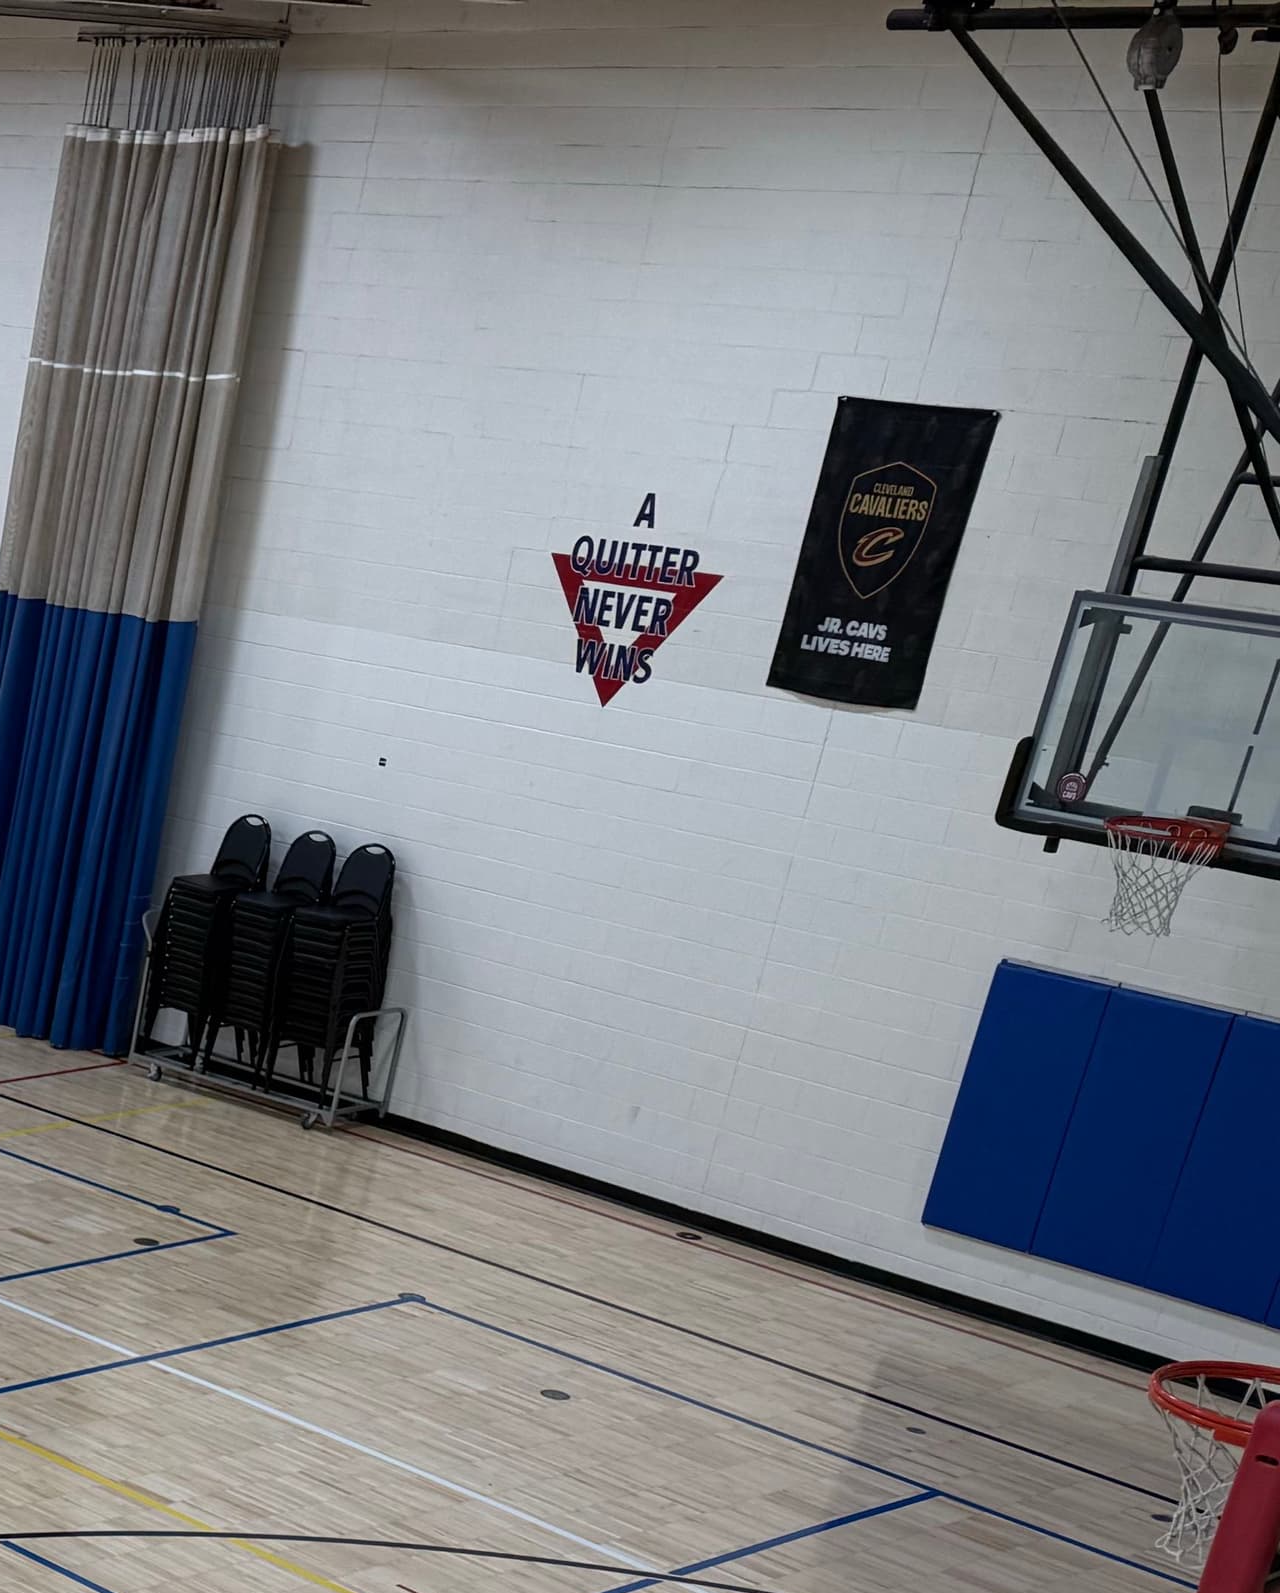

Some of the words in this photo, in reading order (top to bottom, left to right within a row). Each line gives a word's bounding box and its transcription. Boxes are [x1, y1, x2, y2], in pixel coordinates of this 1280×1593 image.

[873, 482, 915, 497] CLEVELAND
[633, 492, 657, 529] A
[849, 493, 930, 521] CAVALIERS
[571, 535, 700, 587] QUITTER
[572, 586, 674, 637] NEVER
[817, 616, 844, 635] JR.
[845, 620, 888, 641] CAVS
[575, 638, 655, 684] WINS
[800, 634, 851, 656] LIVES
[850, 641, 892, 663] HERE
